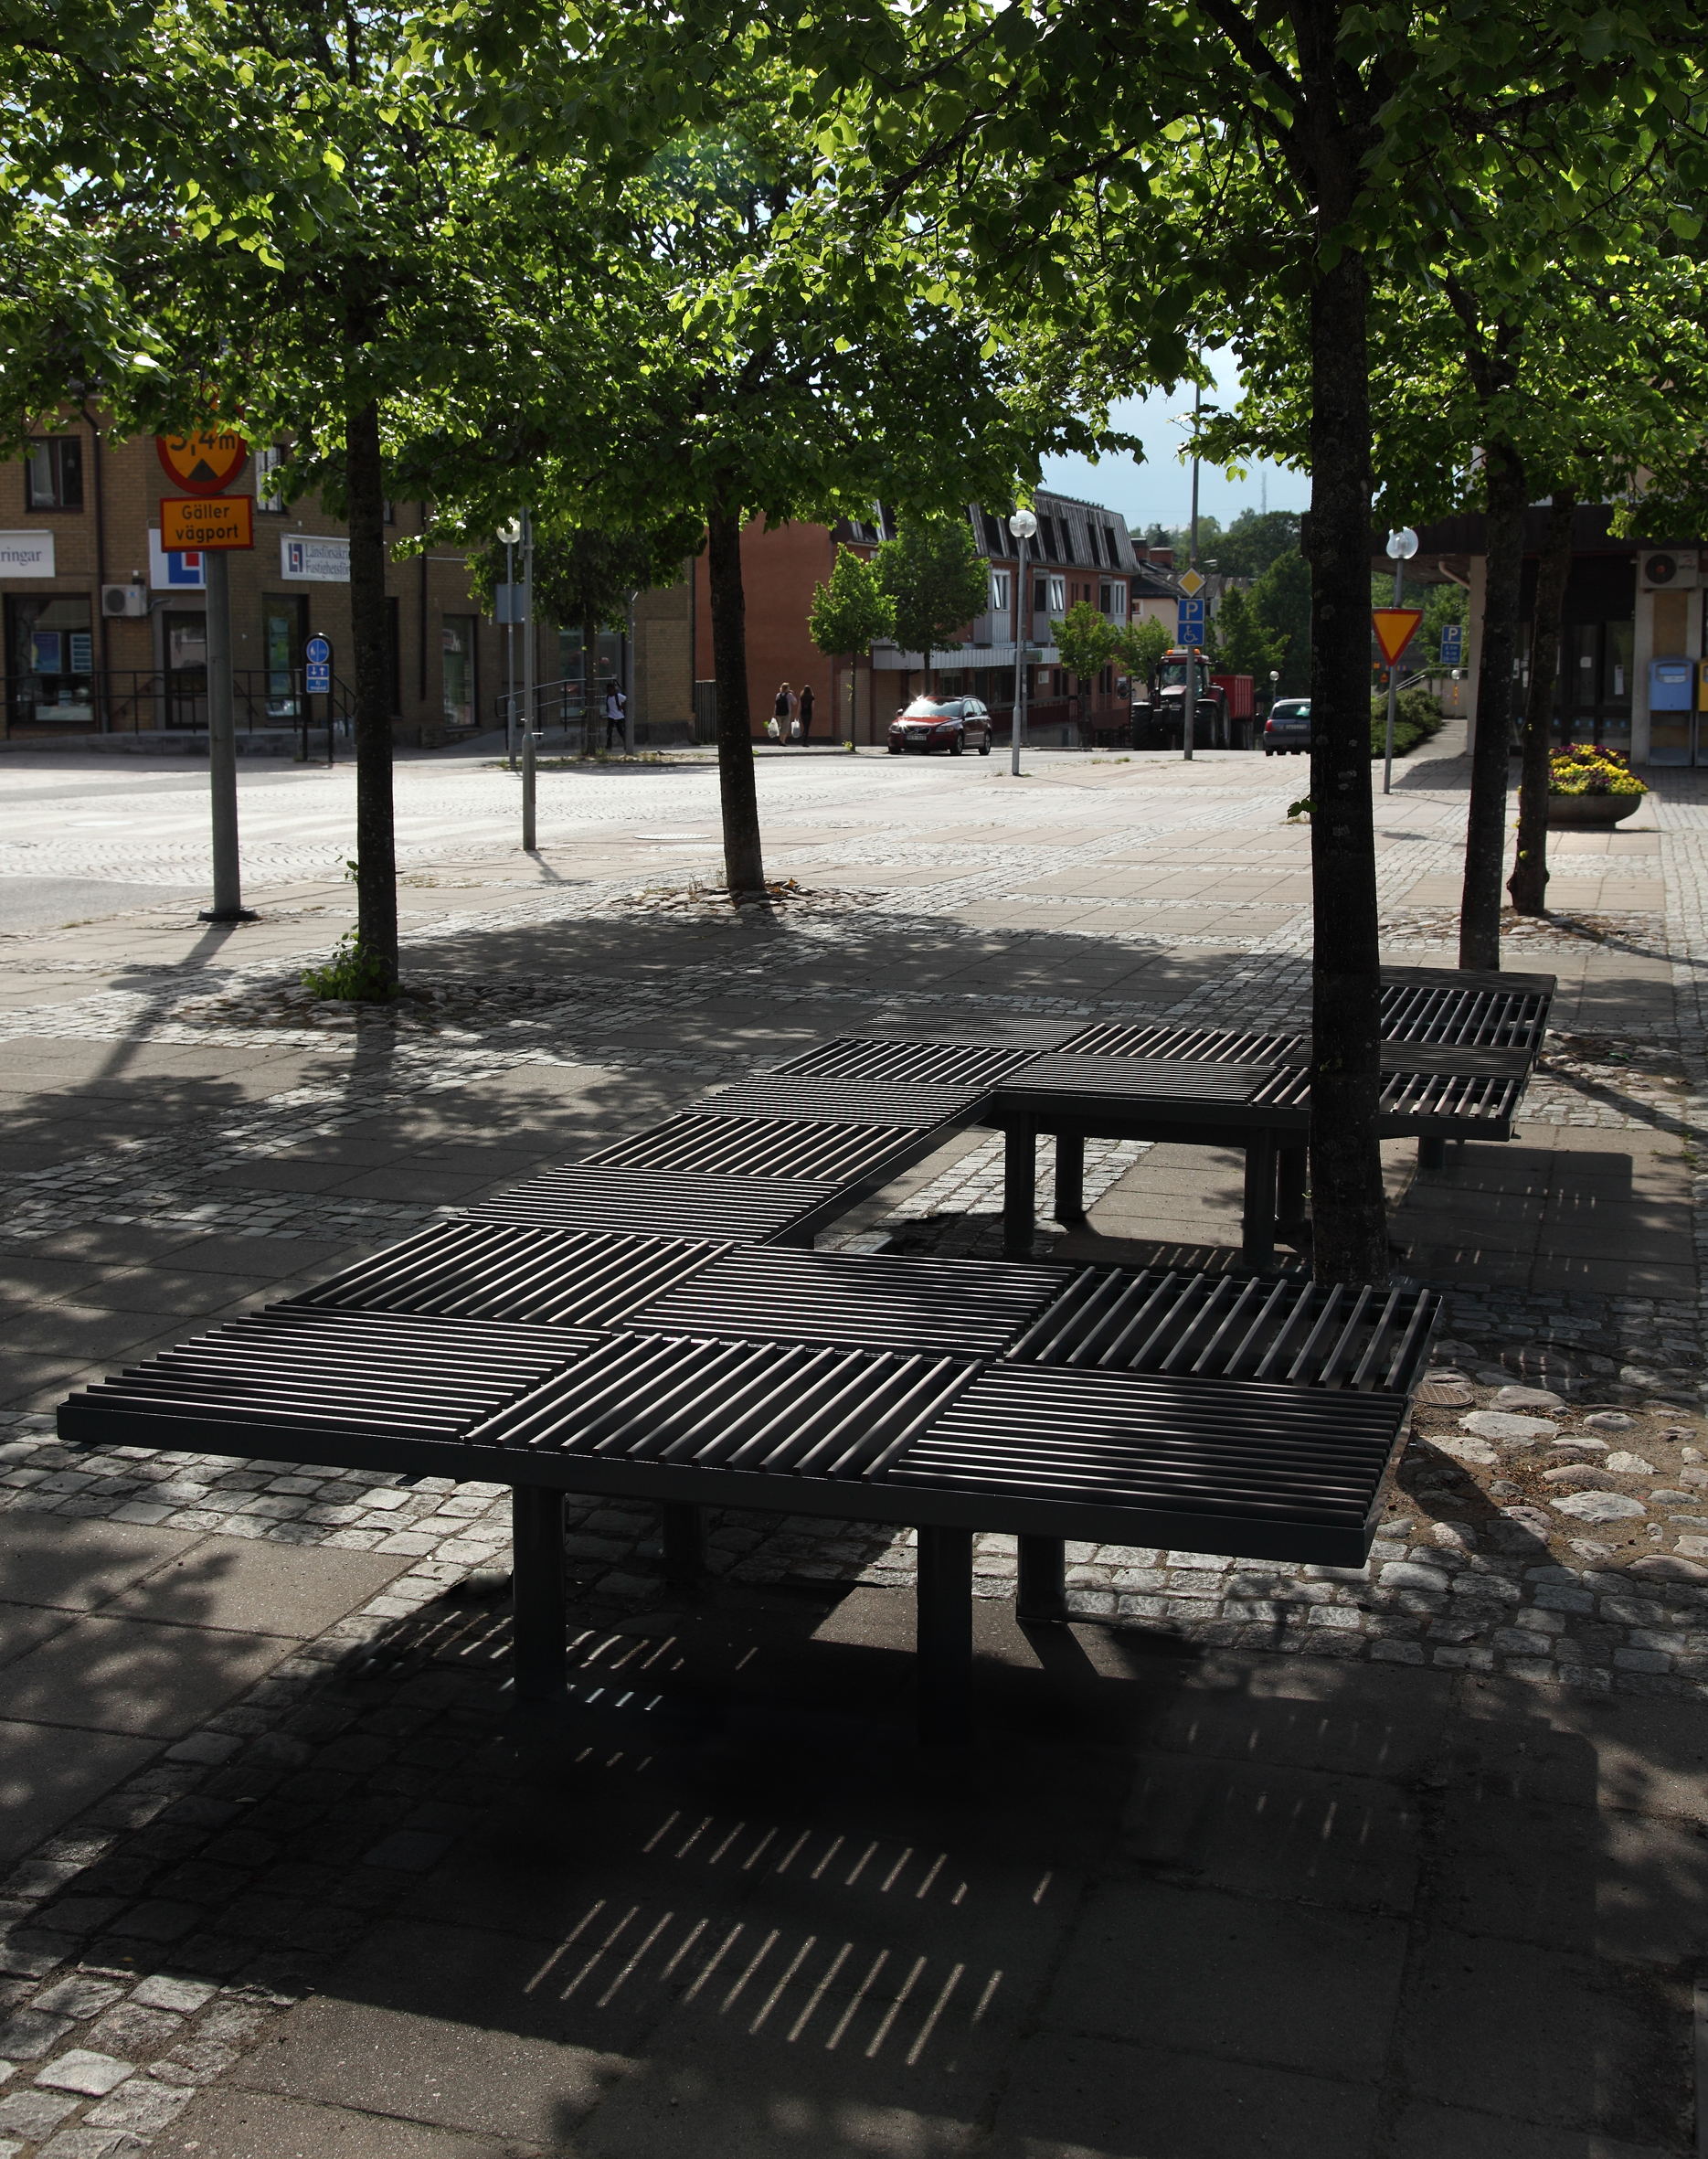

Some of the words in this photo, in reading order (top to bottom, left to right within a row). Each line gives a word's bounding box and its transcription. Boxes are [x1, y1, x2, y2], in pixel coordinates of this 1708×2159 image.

[182, 505, 229, 520] Gäller
[175, 525, 239, 543] vägport
[1186, 601, 1198, 620] P
[1448, 627, 1459, 641] P
